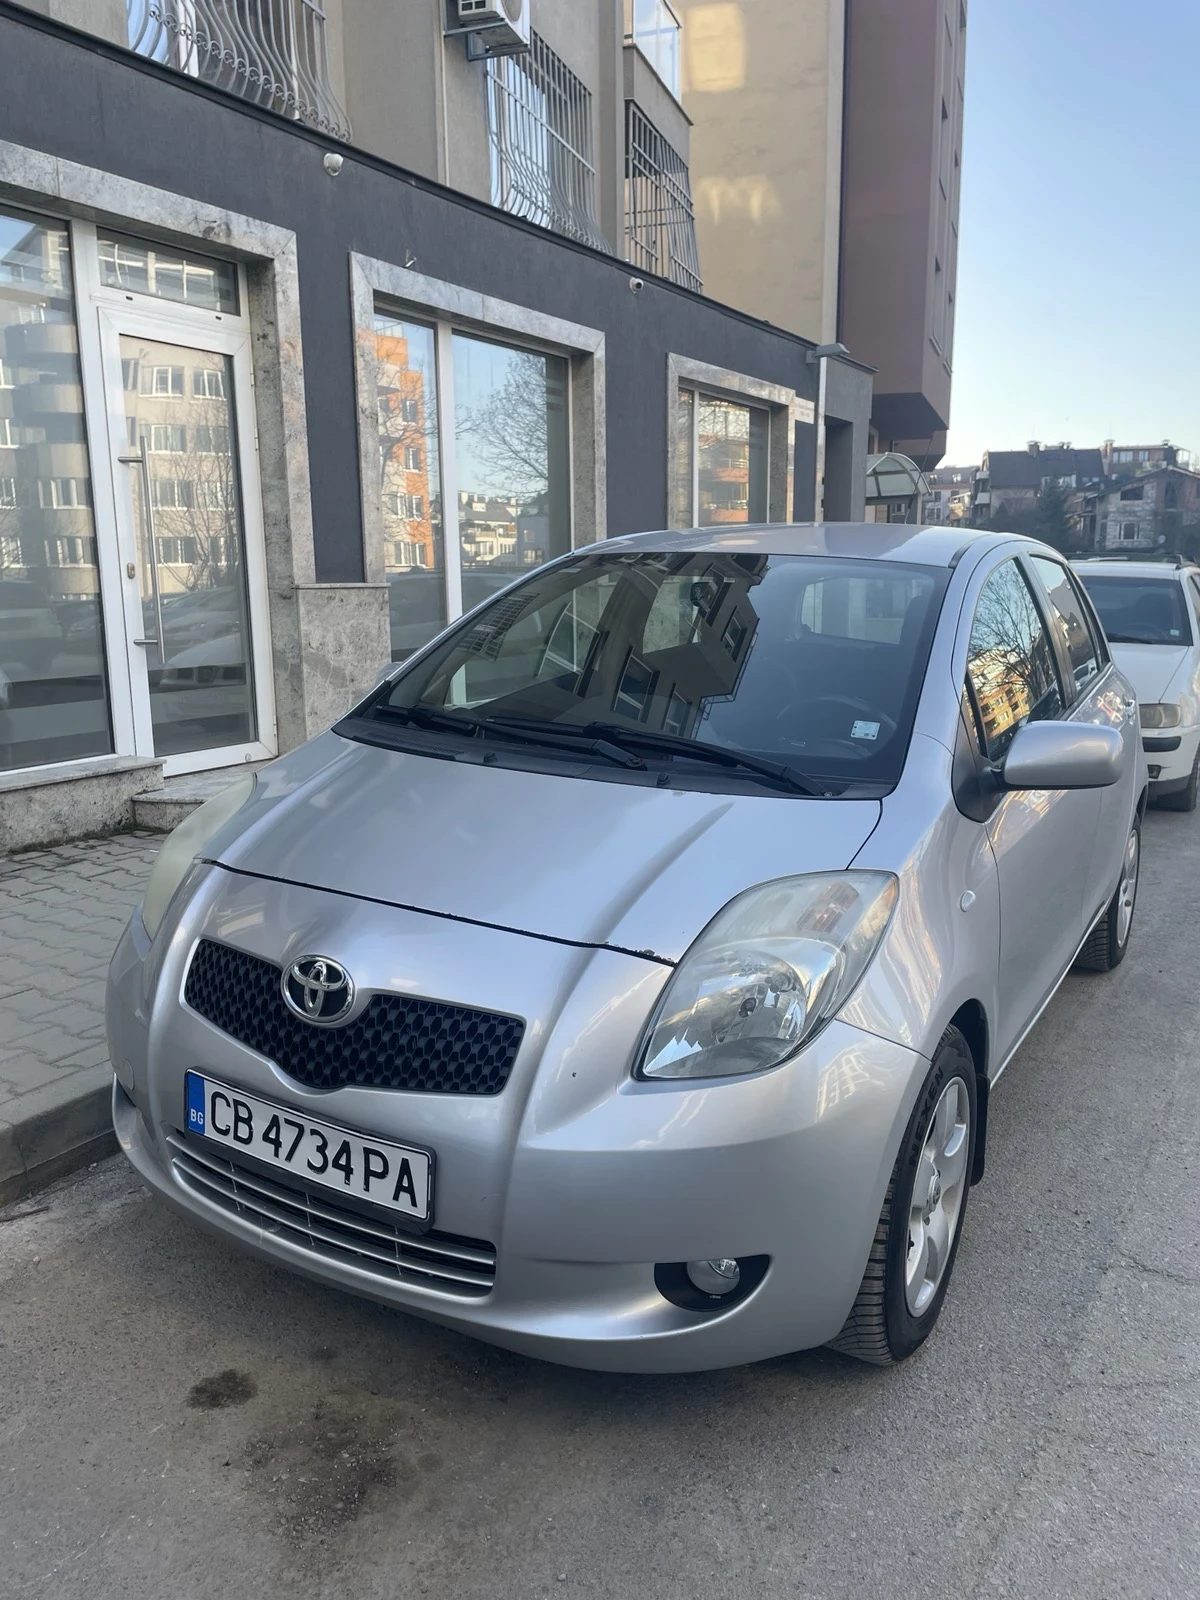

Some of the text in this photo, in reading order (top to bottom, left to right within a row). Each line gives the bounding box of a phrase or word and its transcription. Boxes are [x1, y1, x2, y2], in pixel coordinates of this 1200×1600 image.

[190, 1108, 204, 1124] BG
[262, 1115, 354, 1186] 4734
[909, 1065, 943, 1167] NEXEN
